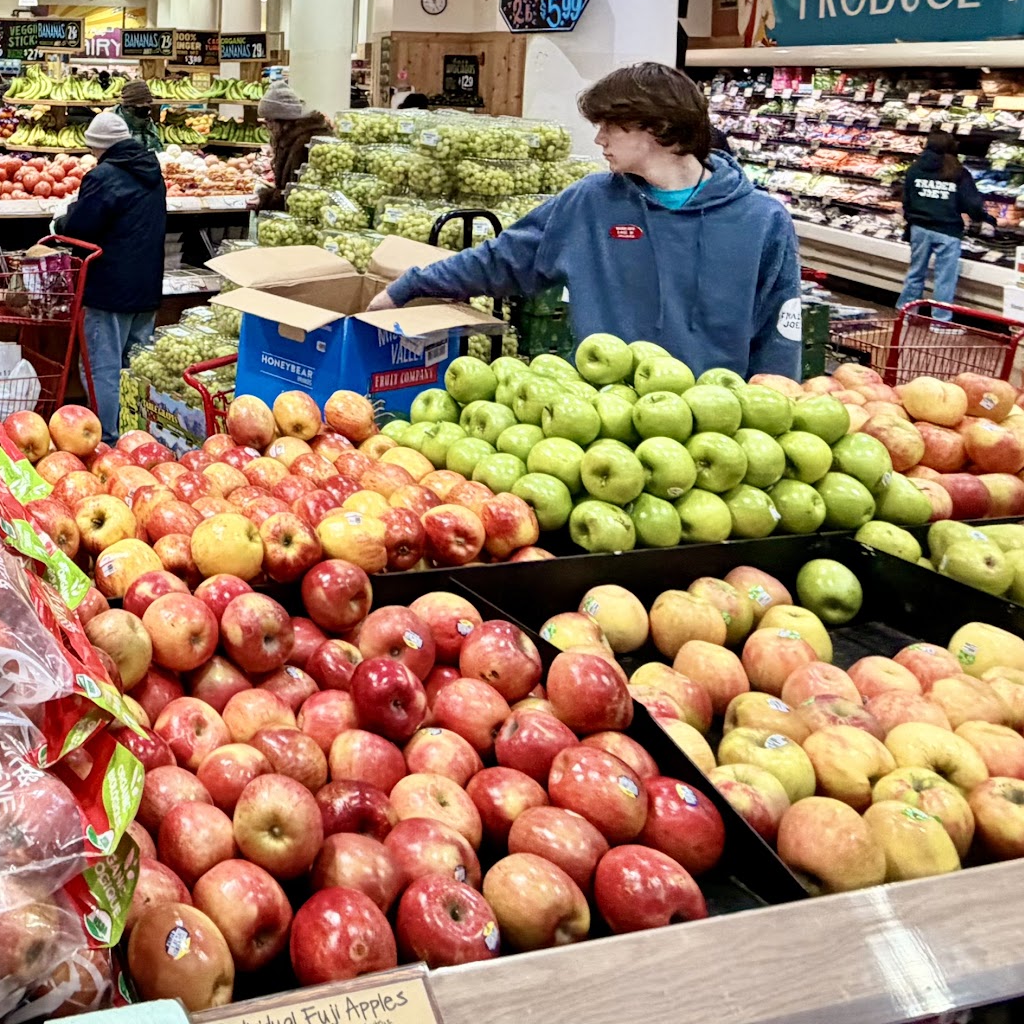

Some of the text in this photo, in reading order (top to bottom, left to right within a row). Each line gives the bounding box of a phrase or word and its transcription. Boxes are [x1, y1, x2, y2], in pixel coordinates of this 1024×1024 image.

[38, 23, 66, 39] BANANAS
[85, 39, 121, 56] AIRY
[125, 33, 158, 47] BANANAS
[176, 42, 201, 50] INGER
[221, 37, 246, 45] ORGANIC
[221, 44, 250, 58] BANANAS
[914, 179, 957, 192] TRADER
[783, 321, 801, 329] JOE
[261, 354, 313, 379] HONEYBEAR
[375, 367, 434, 389] FRUIT COMPANY
[106, 853, 127, 894] GANIC
[94, 861, 122, 918] OGIQUE
[301, 1004, 340, 1024] Fuji
[346, 989, 409, 1020] Apples
